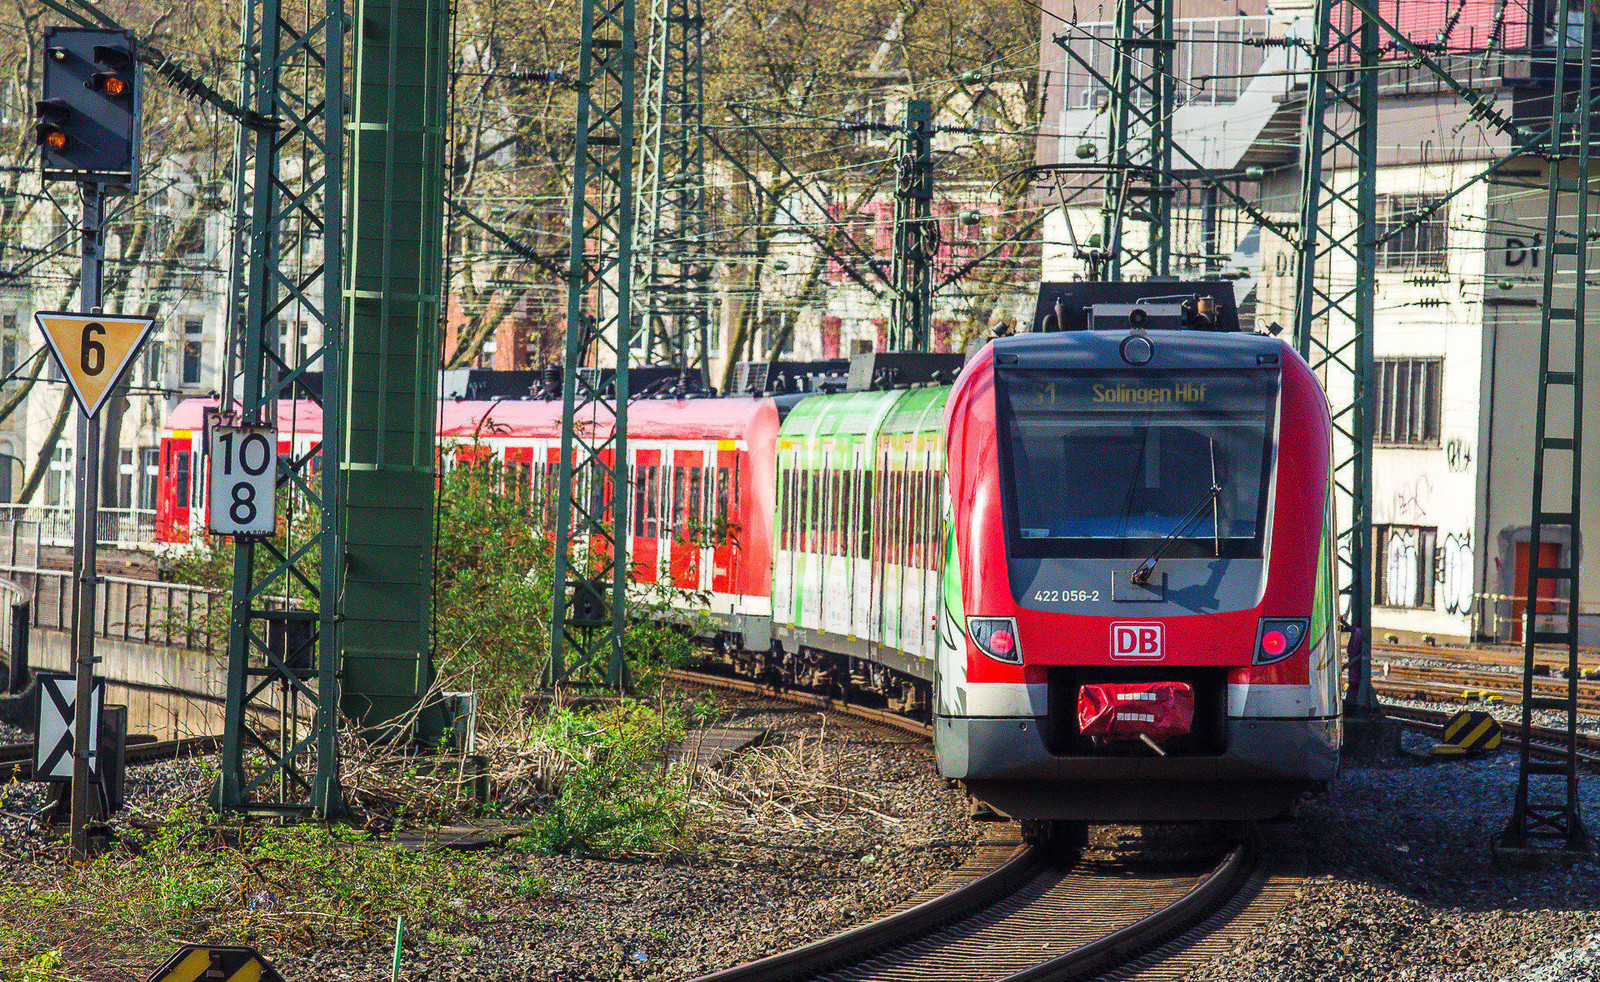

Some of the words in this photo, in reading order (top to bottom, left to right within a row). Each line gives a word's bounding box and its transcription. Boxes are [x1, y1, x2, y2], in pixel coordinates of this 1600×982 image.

[80, 322, 106, 376] 6
[1092, 383, 1171, 404] Solingen
[1174, 383, 1207, 402] Hbf
[220, 432, 271, 476] 10
[229, 482, 257, 525] 8
[1034, 590, 1059, 602] 422
[1062, 590, 1100, 602] 056-2
[1115, 626, 1160, 655] DB
